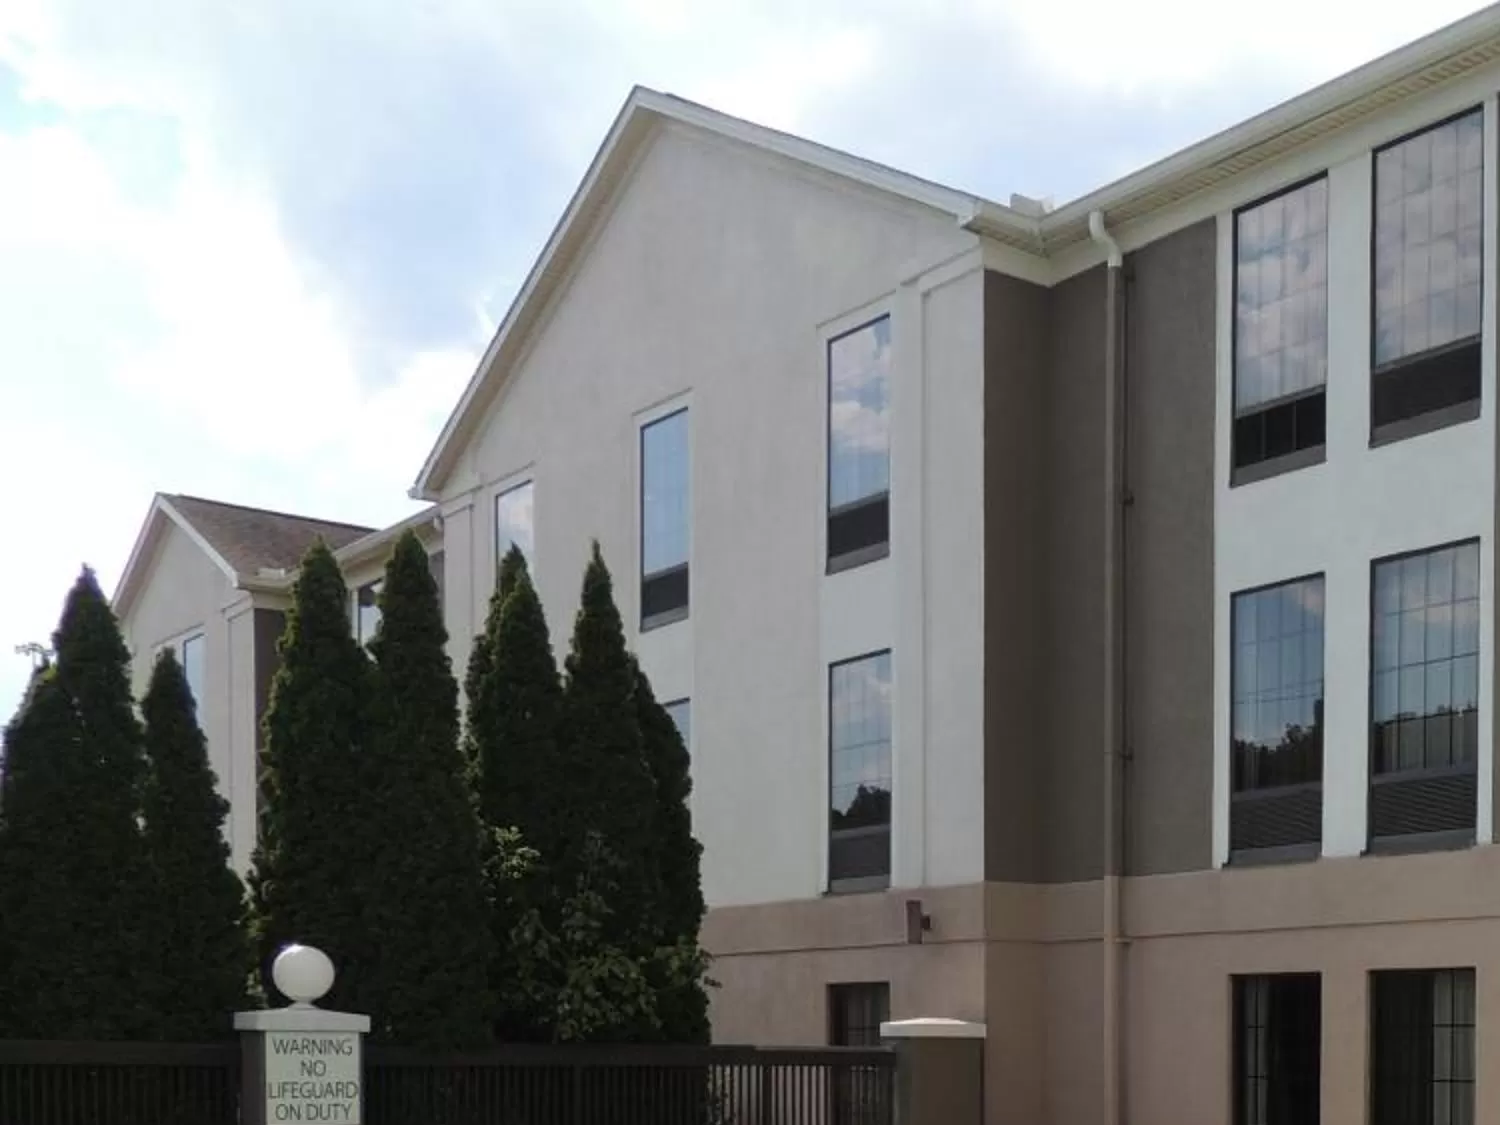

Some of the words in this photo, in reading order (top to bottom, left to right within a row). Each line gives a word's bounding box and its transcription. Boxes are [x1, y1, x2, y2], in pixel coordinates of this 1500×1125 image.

[272, 1037, 352, 1056] WARNING
[300, 1059, 326, 1077] NO
[268, 1081, 358, 1099] LIFEGUARD
[275, 1103, 301, 1121] ON
[306, 1103, 353, 1121] DUTY
